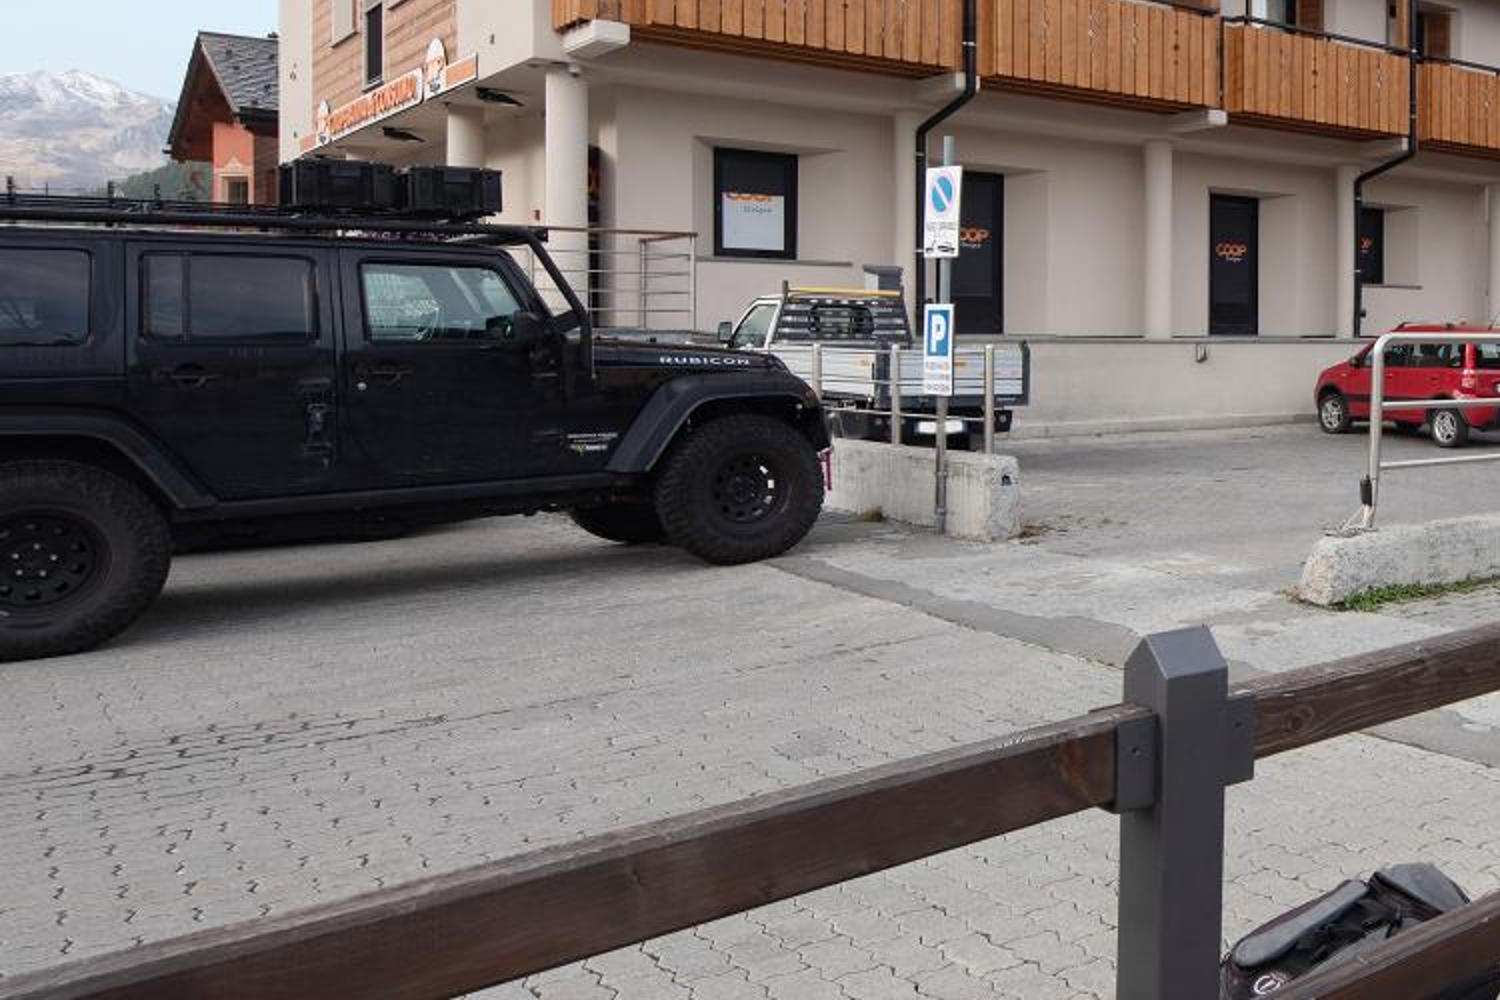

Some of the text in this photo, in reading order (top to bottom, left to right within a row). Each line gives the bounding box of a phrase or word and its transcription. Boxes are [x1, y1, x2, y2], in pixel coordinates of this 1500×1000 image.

[958, 227, 989, 242] OOP
[1216, 243, 1247, 256] COOP
[930, 314, 947, 353] P
[659, 356, 750, 366] RUBICON
